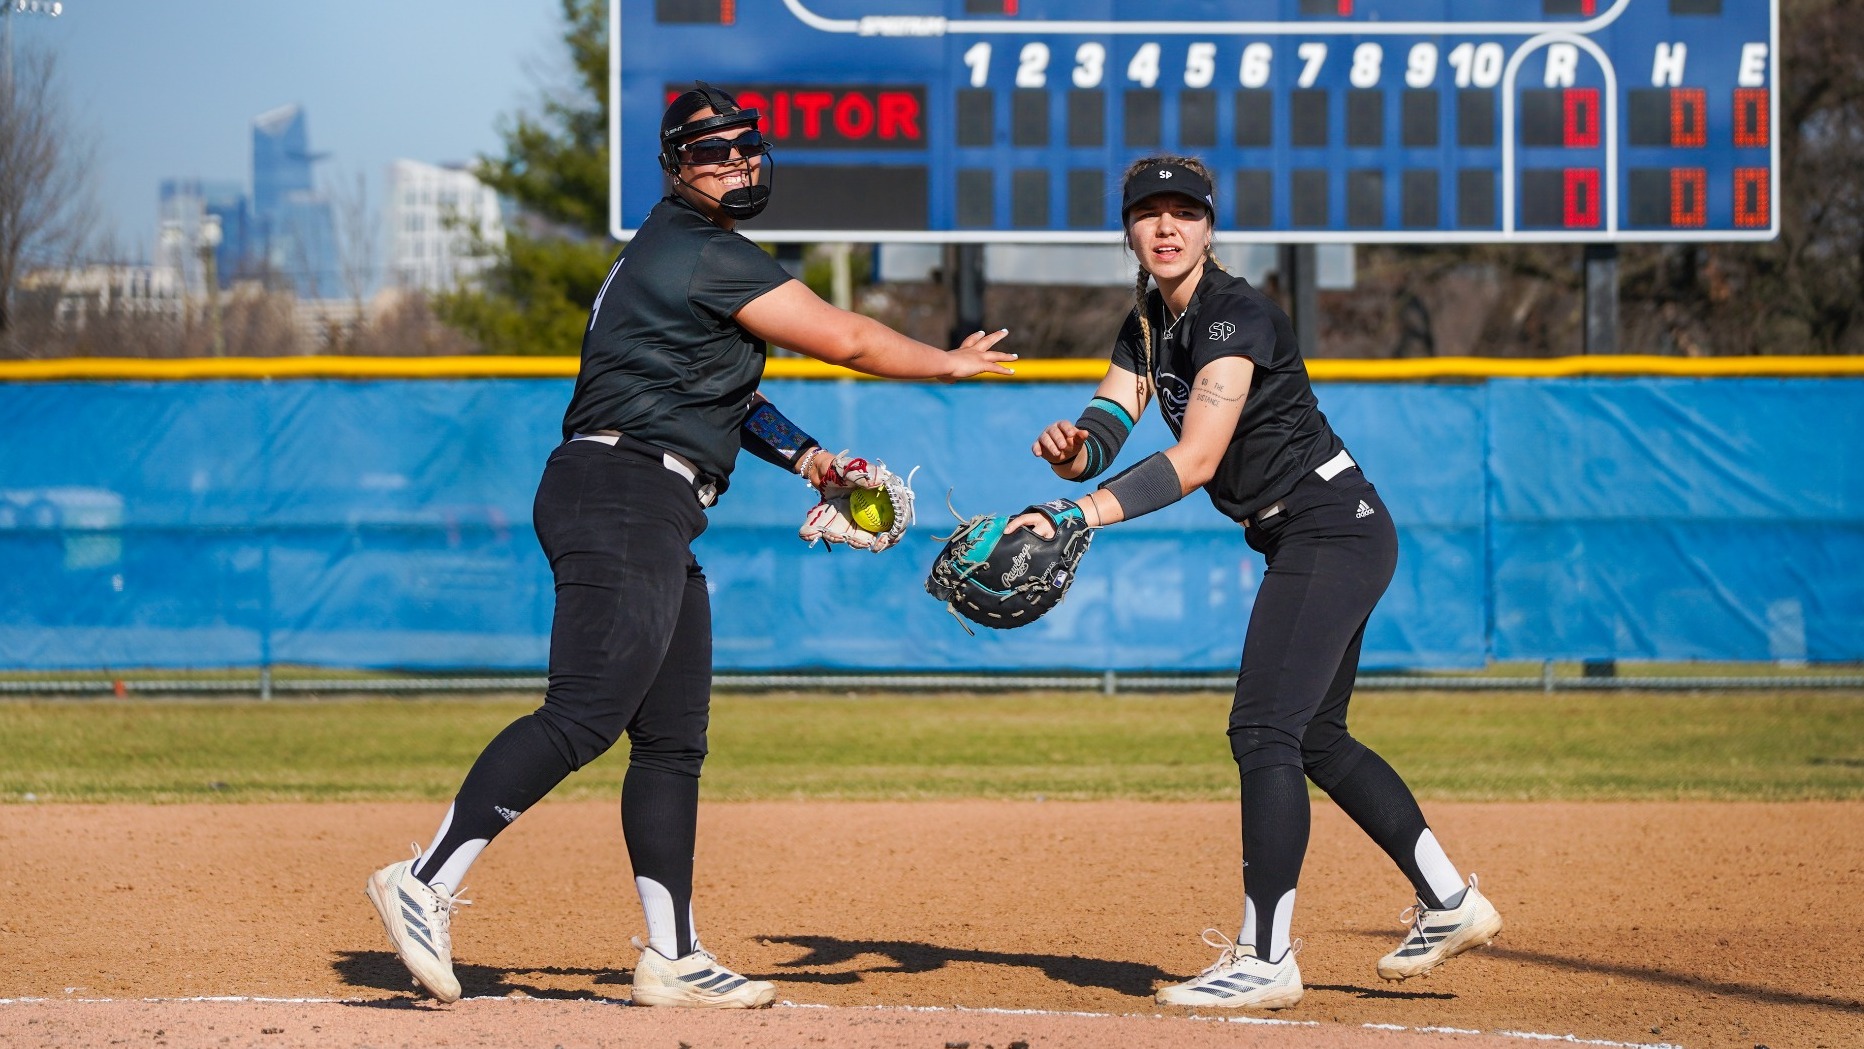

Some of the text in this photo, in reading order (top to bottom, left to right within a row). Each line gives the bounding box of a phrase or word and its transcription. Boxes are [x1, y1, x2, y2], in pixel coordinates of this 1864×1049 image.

[963, 41, 1769, 88] 1 2 3 4 5 6 7 8 9 10 R H E
[667, 91, 920, 140] SITOR
[1563, 89, 1769, 147] 0 0 0
[1159, 169, 1173, 179] SP
[1563, 169, 1769, 227] 0 0 0
[1208, 321, 1236, 341] SP
[1002, 543, 1032, 588] Rawlings
